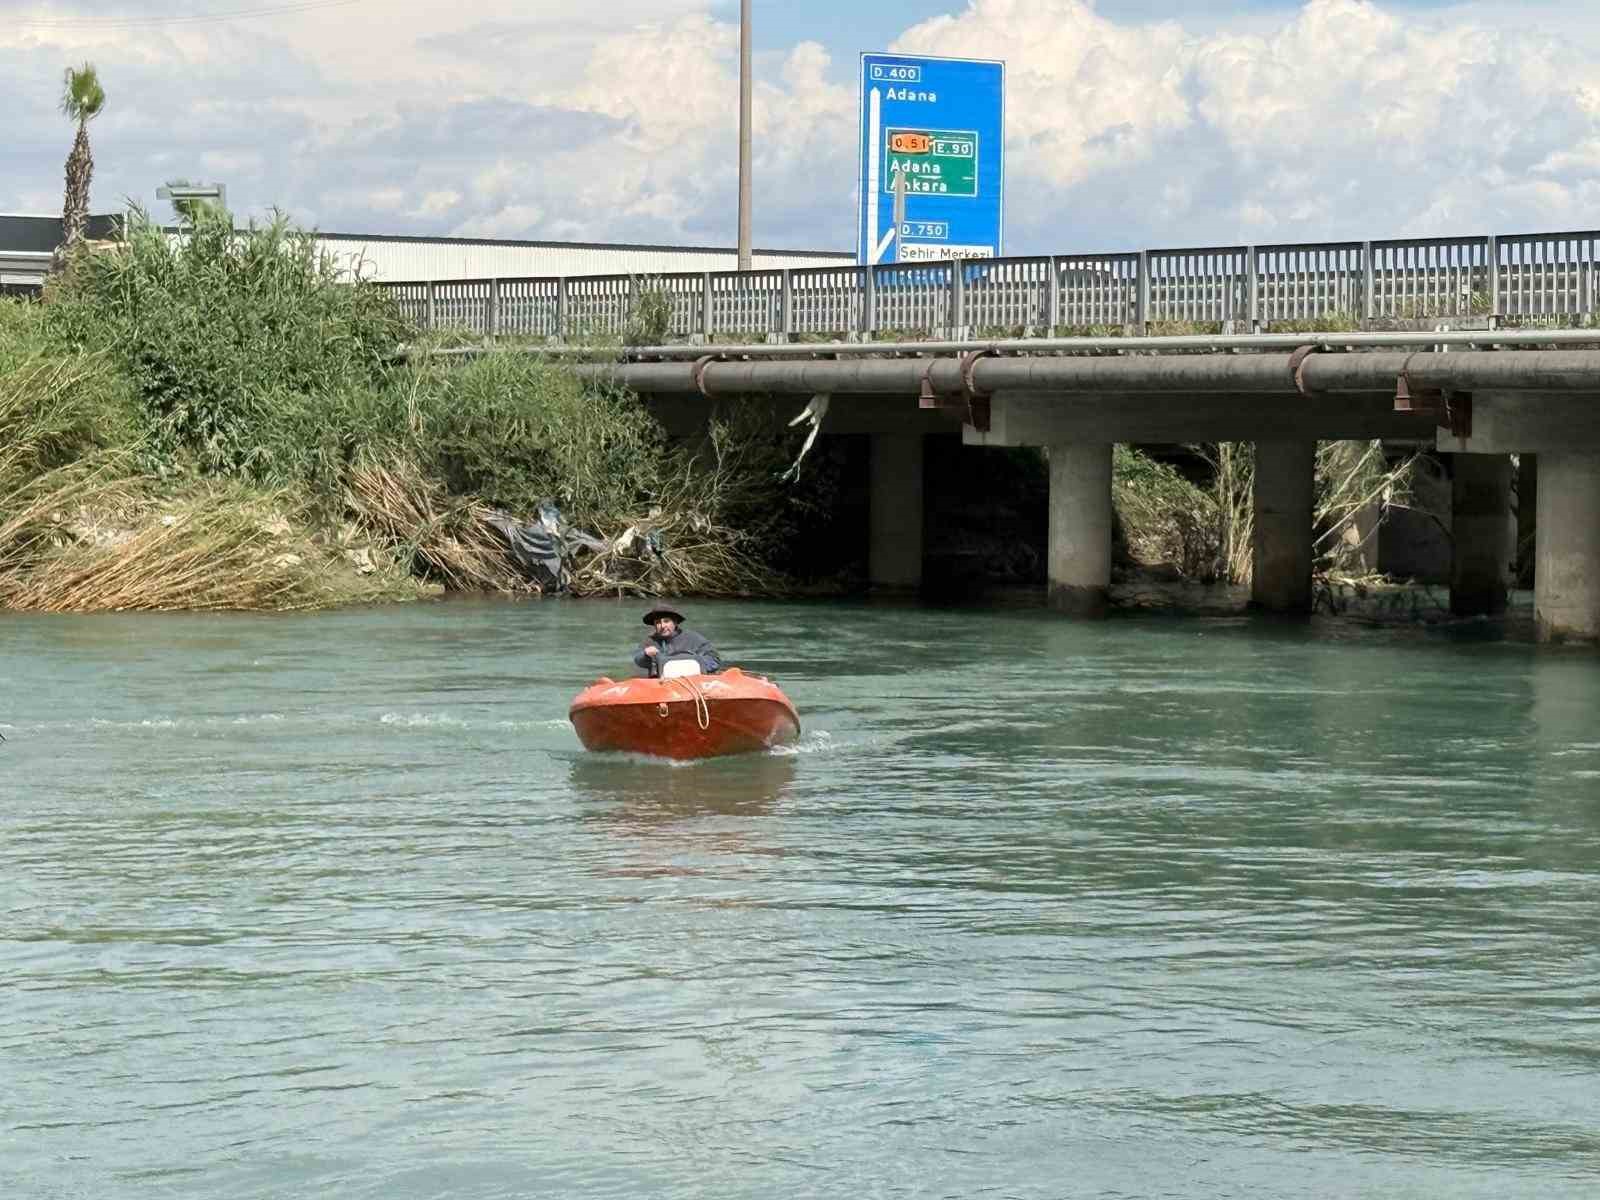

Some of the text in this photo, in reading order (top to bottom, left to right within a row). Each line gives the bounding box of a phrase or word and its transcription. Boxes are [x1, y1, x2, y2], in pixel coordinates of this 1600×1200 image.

[873, 66, 917, 80] D.400
[886, 87, 937, 103] Adana
[936, 142, 970, 154] E.90
[890, 159, 941, 174] Adana
[902, 224, 943, 236] D.750
